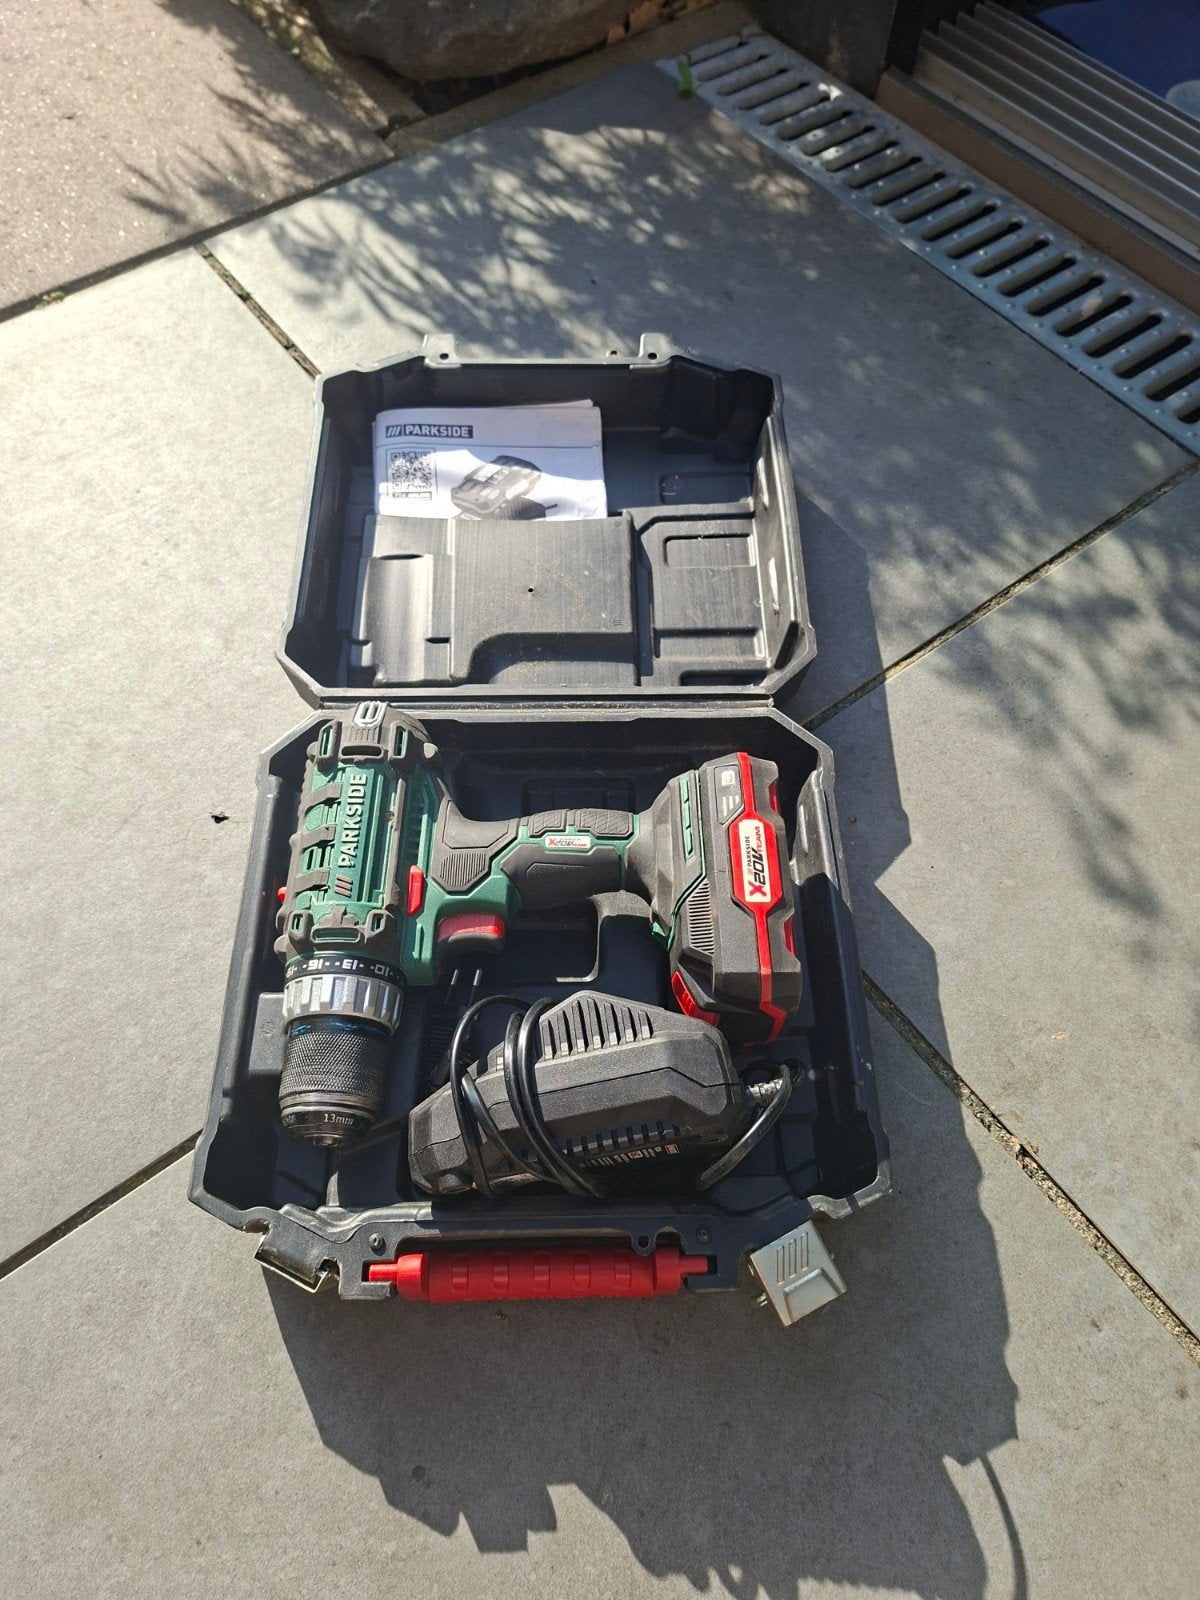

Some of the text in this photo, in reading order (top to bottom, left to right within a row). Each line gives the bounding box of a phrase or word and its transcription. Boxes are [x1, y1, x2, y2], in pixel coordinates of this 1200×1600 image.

[405, 425, 469, 437] PARKSIDE
[339, 774, 366, 868] PARKSIDE
[323, 1113, 354, 1125] 13mm
